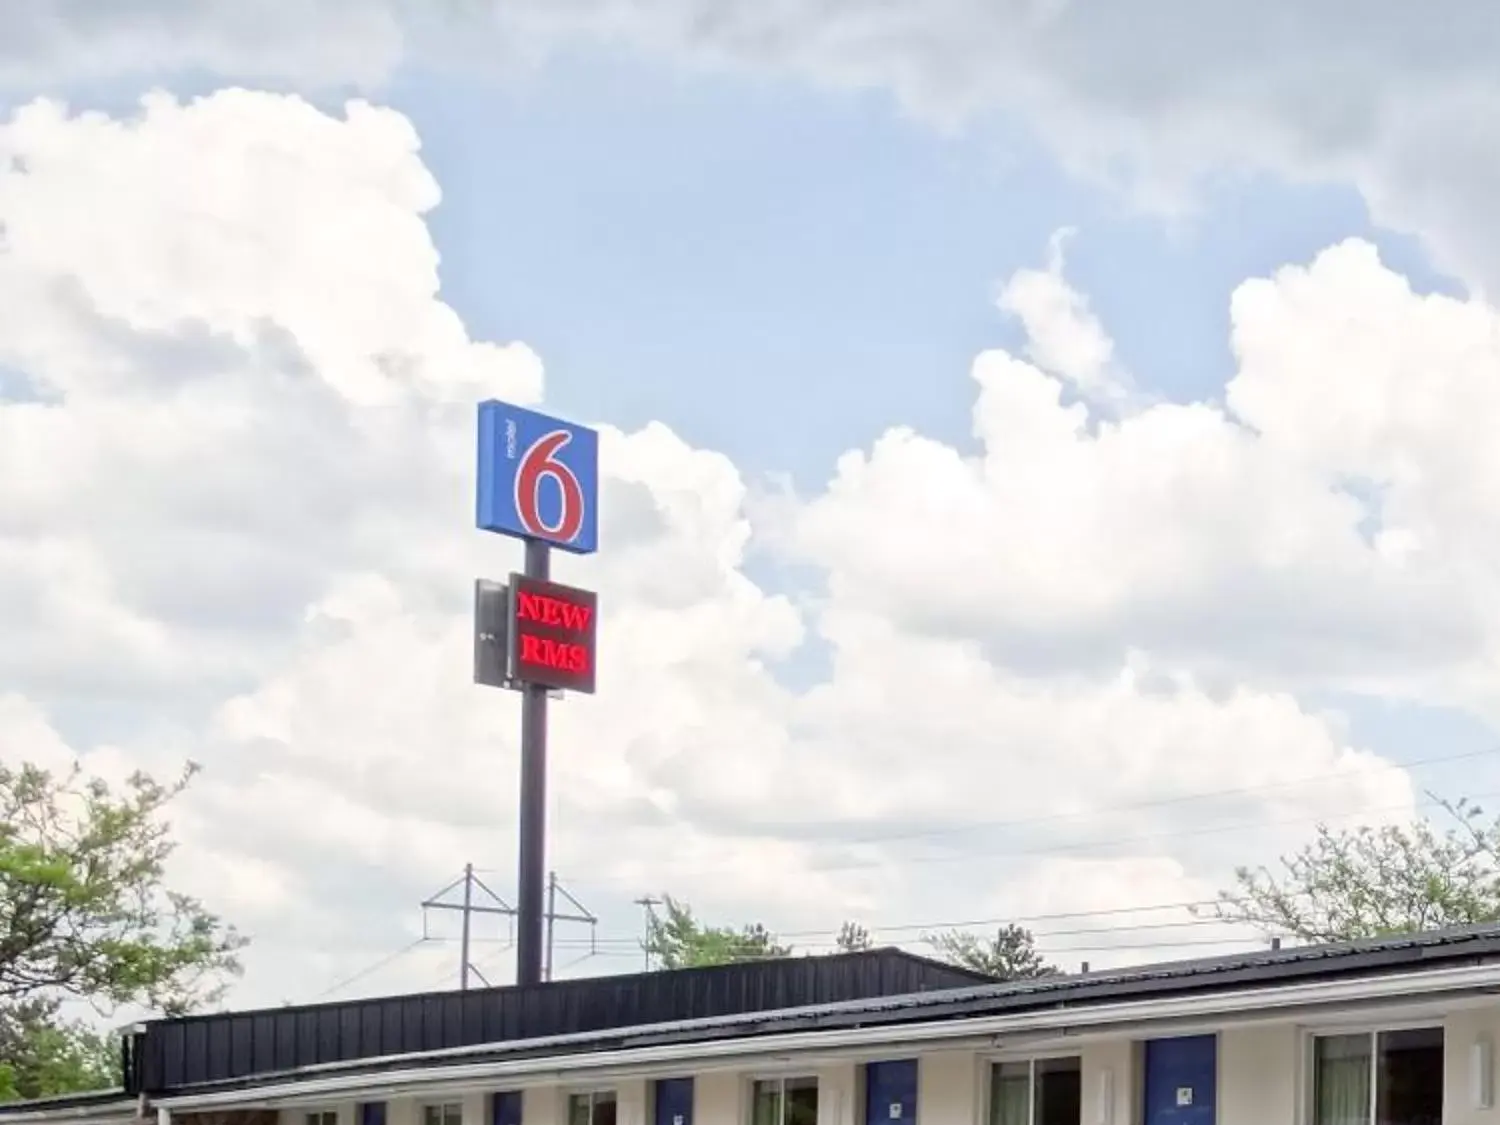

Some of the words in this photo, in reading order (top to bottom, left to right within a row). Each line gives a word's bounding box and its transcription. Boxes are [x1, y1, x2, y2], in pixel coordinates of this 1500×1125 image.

[514, 429, 584, 543] 6
[516, 591, 592, 631] NEW
[520, 634, 588, 673] RMS
